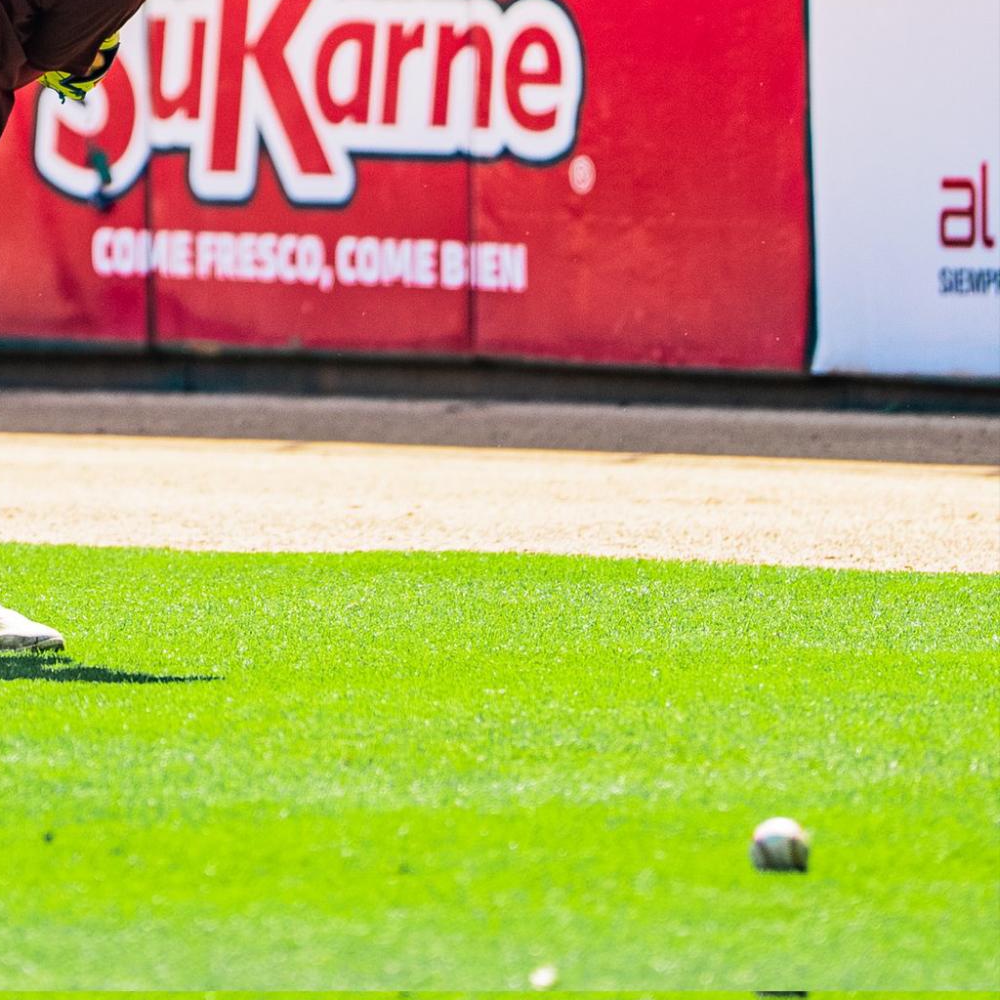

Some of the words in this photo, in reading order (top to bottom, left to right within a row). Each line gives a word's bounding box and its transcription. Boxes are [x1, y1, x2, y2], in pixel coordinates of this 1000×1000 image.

[91, 226, 193, 279] COME
[195, 230, 335, 293] FRESCO,
[335, 235, 437, 288] COME
[440, 239, 528, 293] BIEN
[938, 267, 1000, 294] SIEMP
